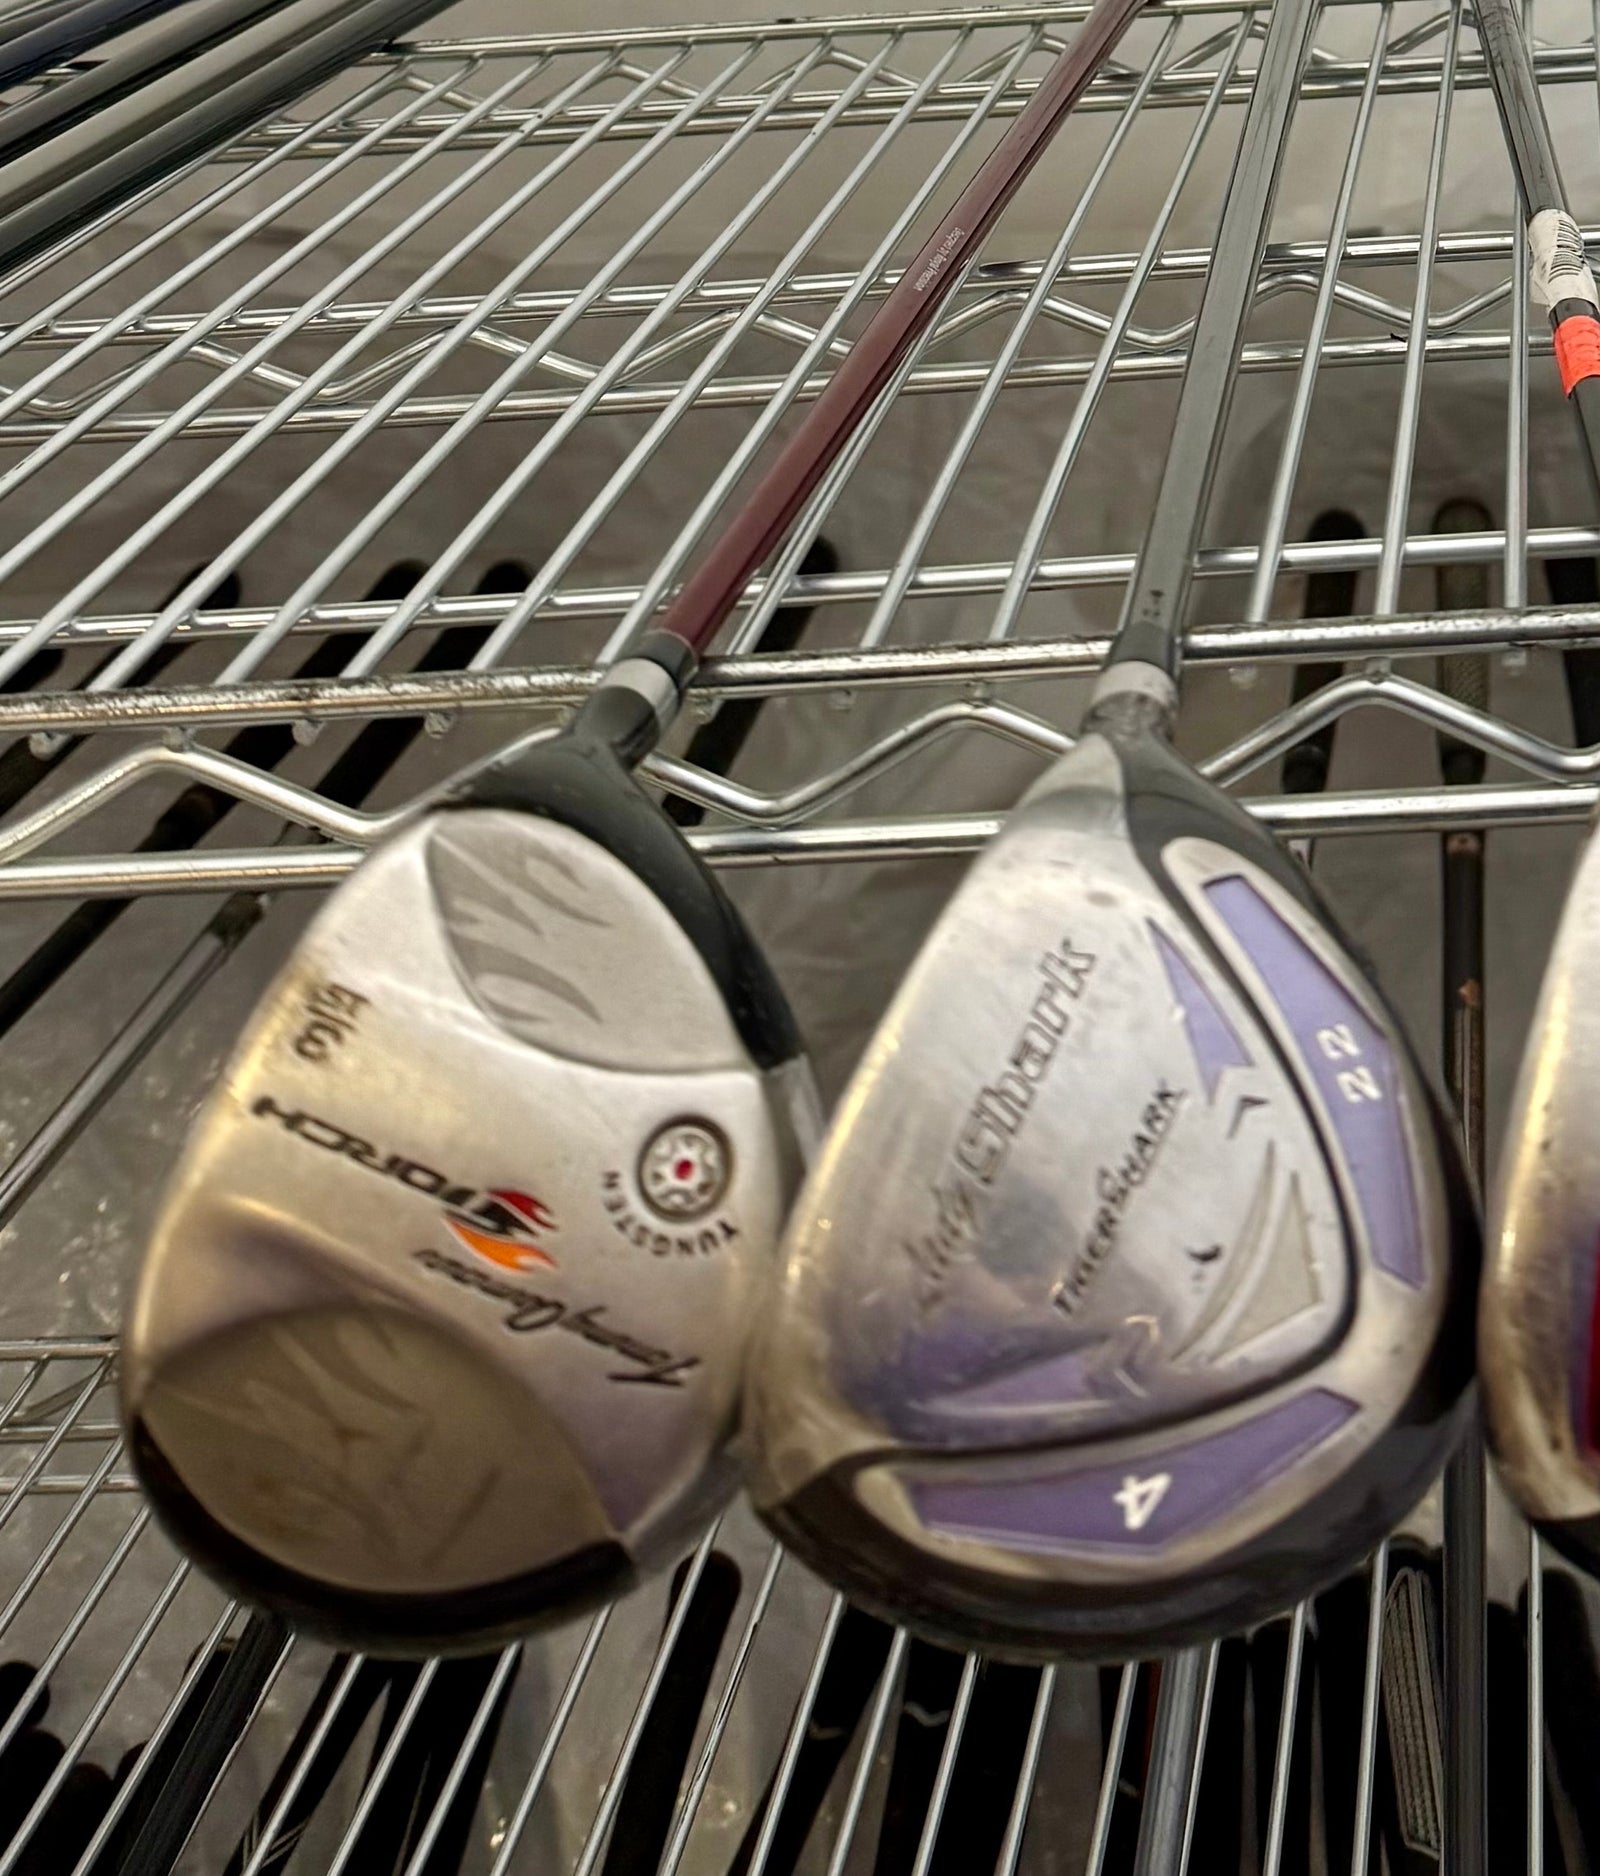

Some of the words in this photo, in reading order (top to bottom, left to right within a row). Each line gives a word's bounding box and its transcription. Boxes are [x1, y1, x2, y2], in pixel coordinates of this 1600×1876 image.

[1316, 1022, 1383, 1102] 22
[599, 1169, 738, 1256] TUNGSTEN
[1112, 1473, 1172, 1530] 4
